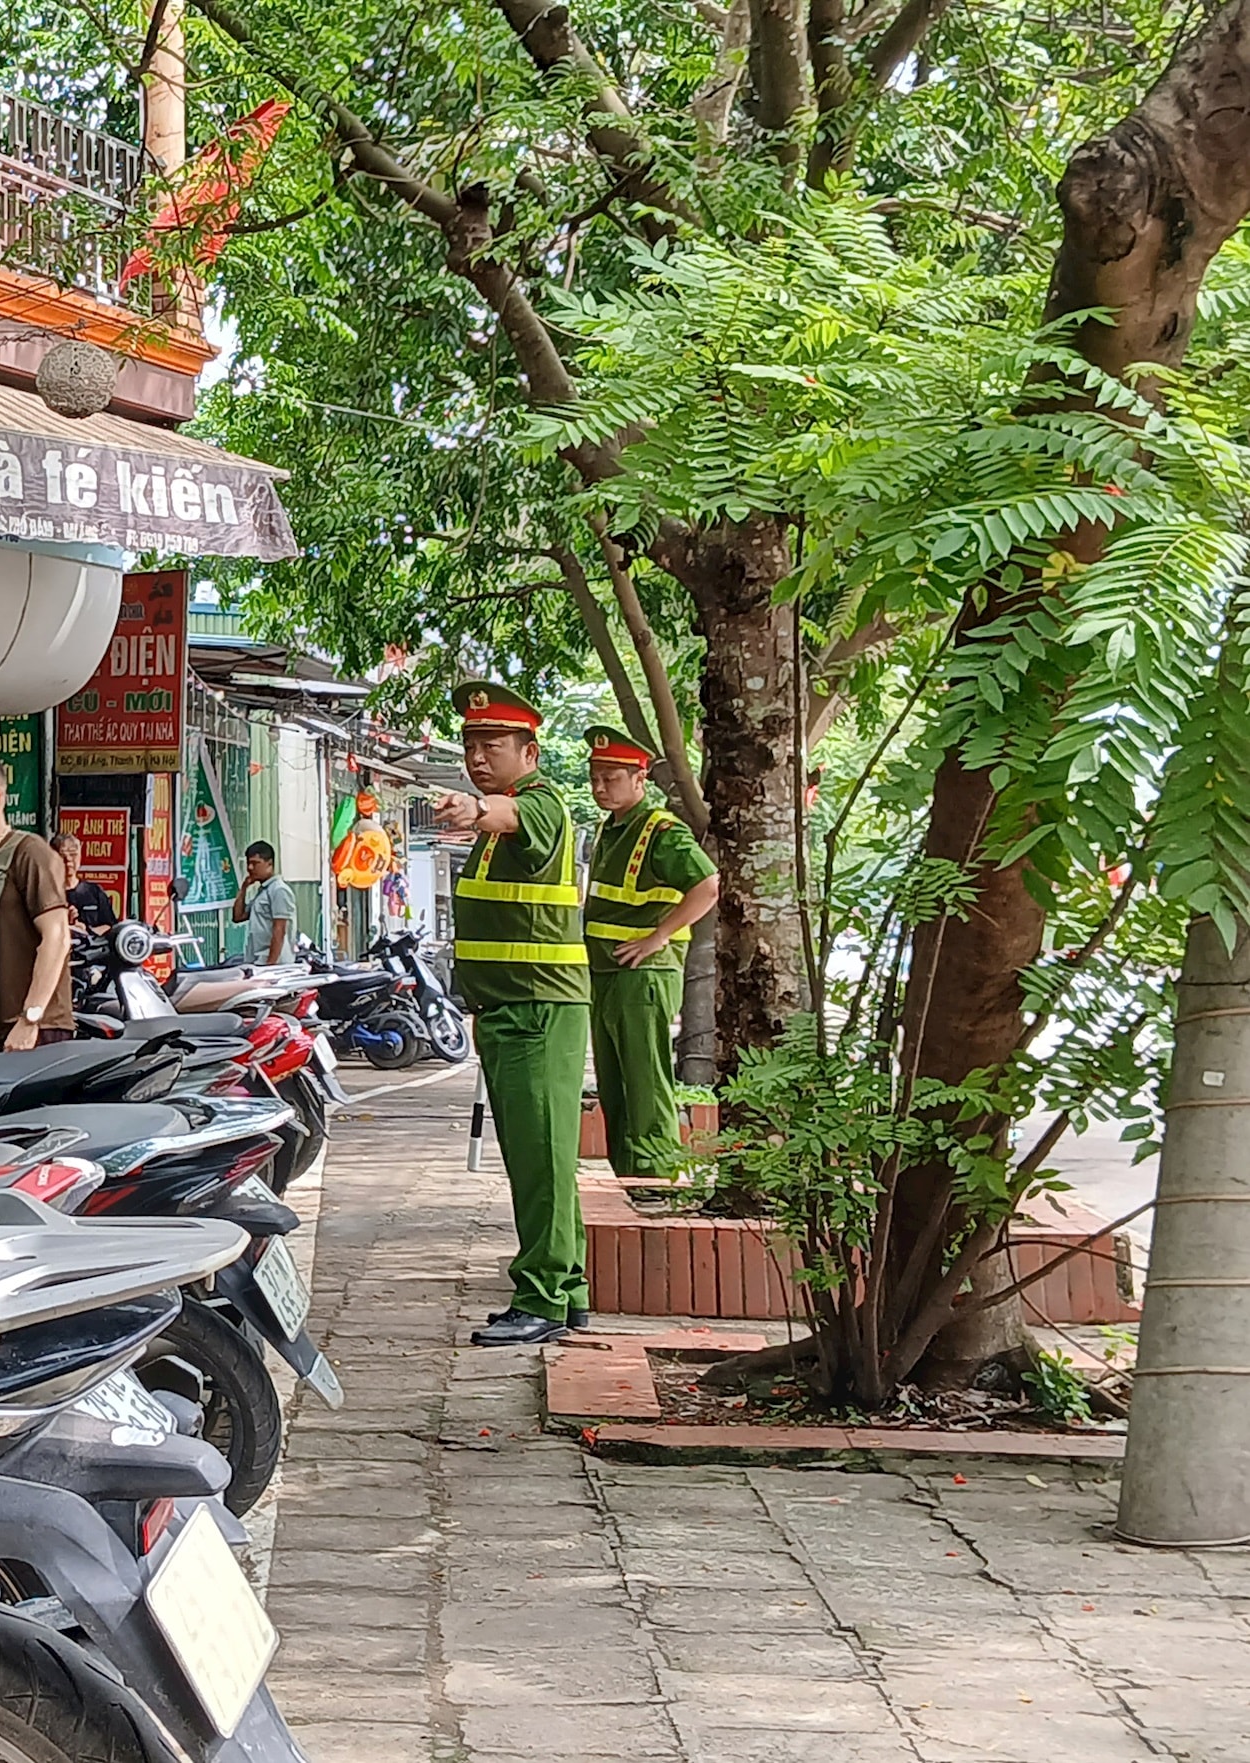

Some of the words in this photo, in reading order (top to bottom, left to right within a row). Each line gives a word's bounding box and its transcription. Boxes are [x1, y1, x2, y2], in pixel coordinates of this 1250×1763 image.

[41, 447, 99, 509] fé
[115, 460, 239, 526] kiến
[110, 626, 176, 686] ĐIỆN
[124, 686, 173, 713] MỚI
[64, 723, 86, 742] THAY
[86, 716, 105, 742] THẾ
[120, 721, 139, 741] QUY
[140, 721, 154, 744] TẠI
